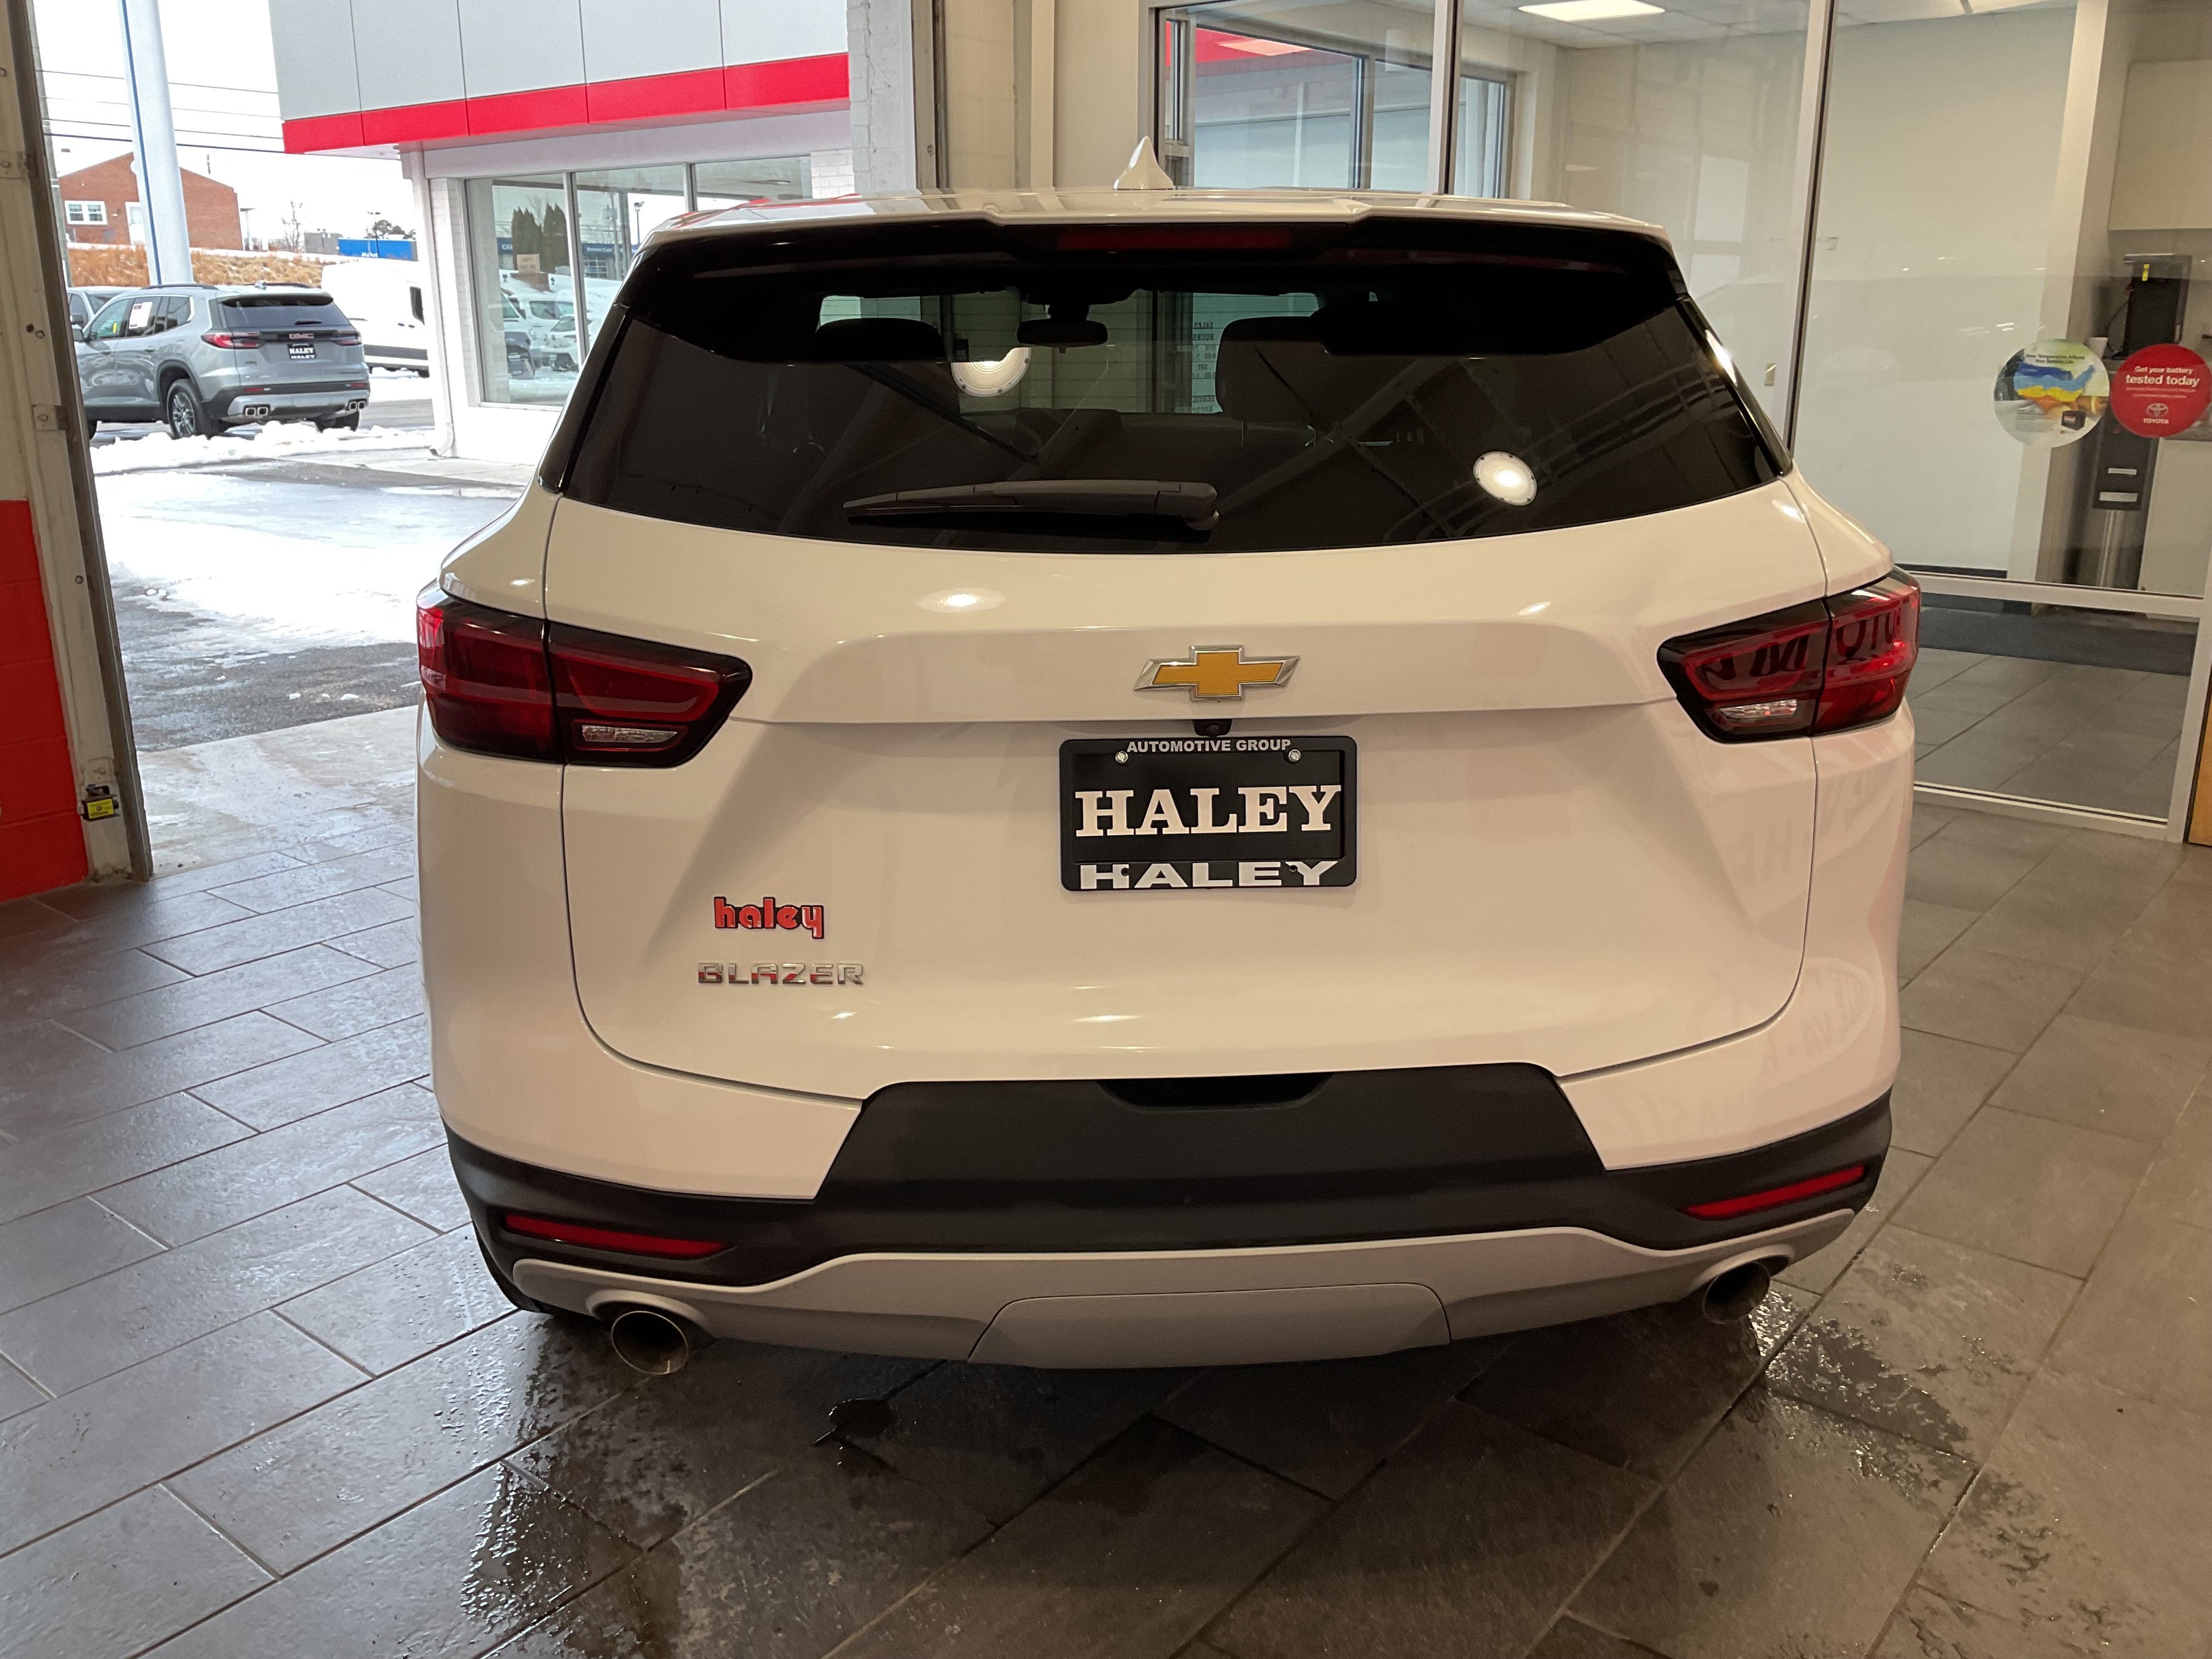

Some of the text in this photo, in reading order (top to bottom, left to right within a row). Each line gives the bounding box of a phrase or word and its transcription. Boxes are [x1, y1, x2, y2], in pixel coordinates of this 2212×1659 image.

[2126, 374, 2200, 387] tested today
[1127, 739, 1291, 753] AUTOMOTIVE GROUP
[1075, 785, 1341, 837] HALEY
[1080, 860, 1339, 890] HALEY
[714, 896, 825, 939] haley
[697, 962, 864, 985] BLAZER
